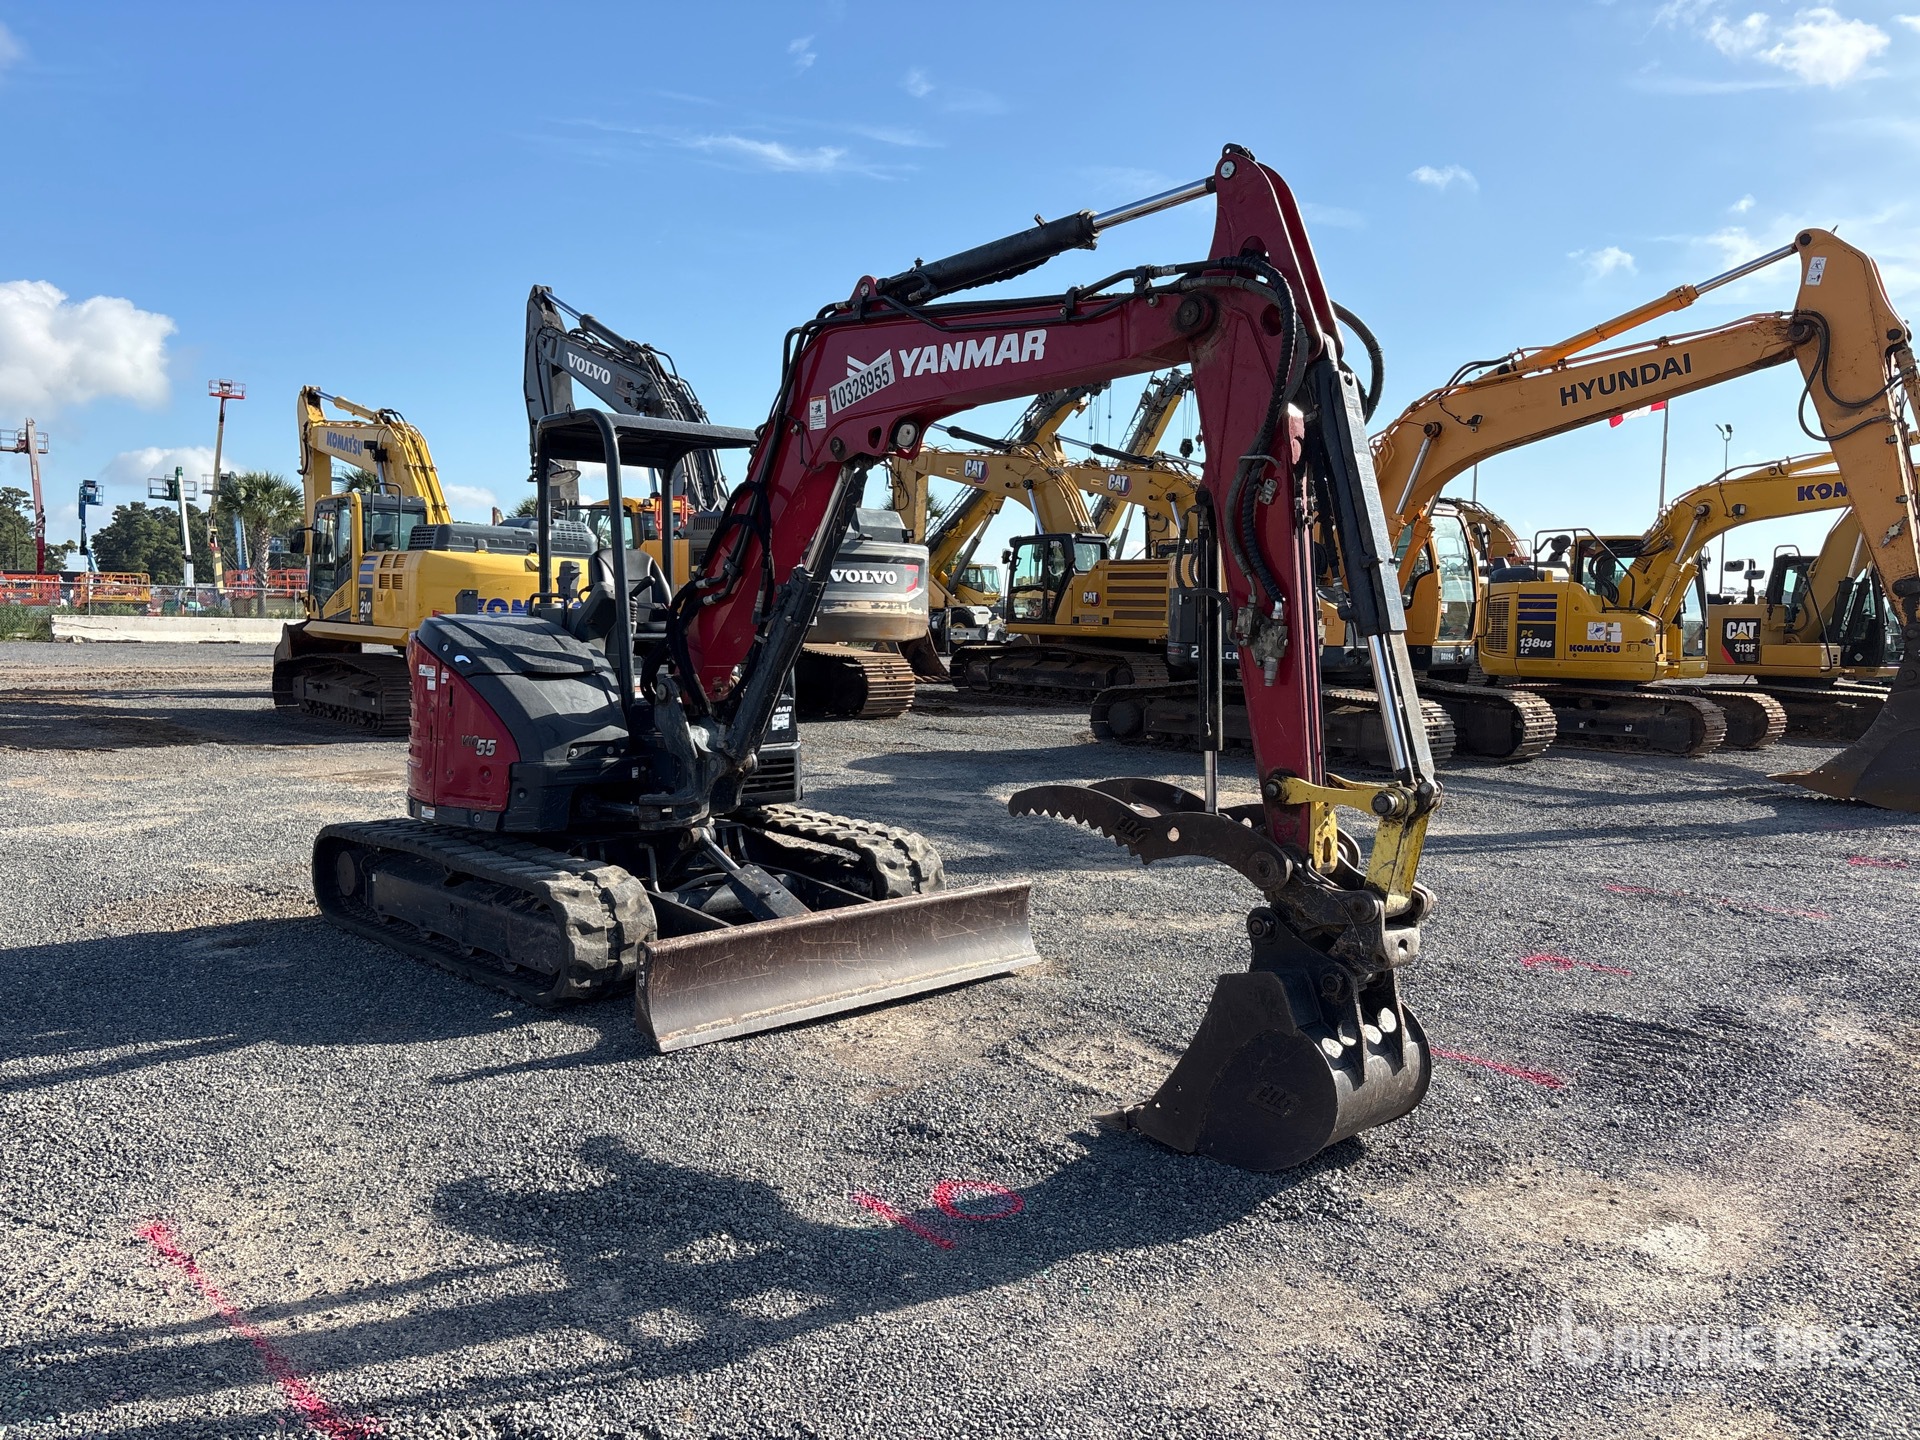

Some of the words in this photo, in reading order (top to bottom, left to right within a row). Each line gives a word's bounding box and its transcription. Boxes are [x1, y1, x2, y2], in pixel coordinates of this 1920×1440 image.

[899, 329, 1047, 378] YANMAR
[567, 352, 611, 385] VOLVO
[832, 362, 890, 411] 10328955
[1560, 353, 1692, 406] HYUNDAI
[326, 431, 363, 456] KOMATSU
[964, 459, 984, 478] CAT
[1107, 474, 1128, 492] CAT
[830, 569, 898, 585] VOLVO
[1083, 592, 1098, 604] CAT
[360, 601, 371, 614] 210
[1520, 629, 1534, 638] PC
[1726, 621, 1757, 640] CAT
[1569, 643, 1620, 654] KOMATSU
[1734, 643, 1756, 653] 313F
